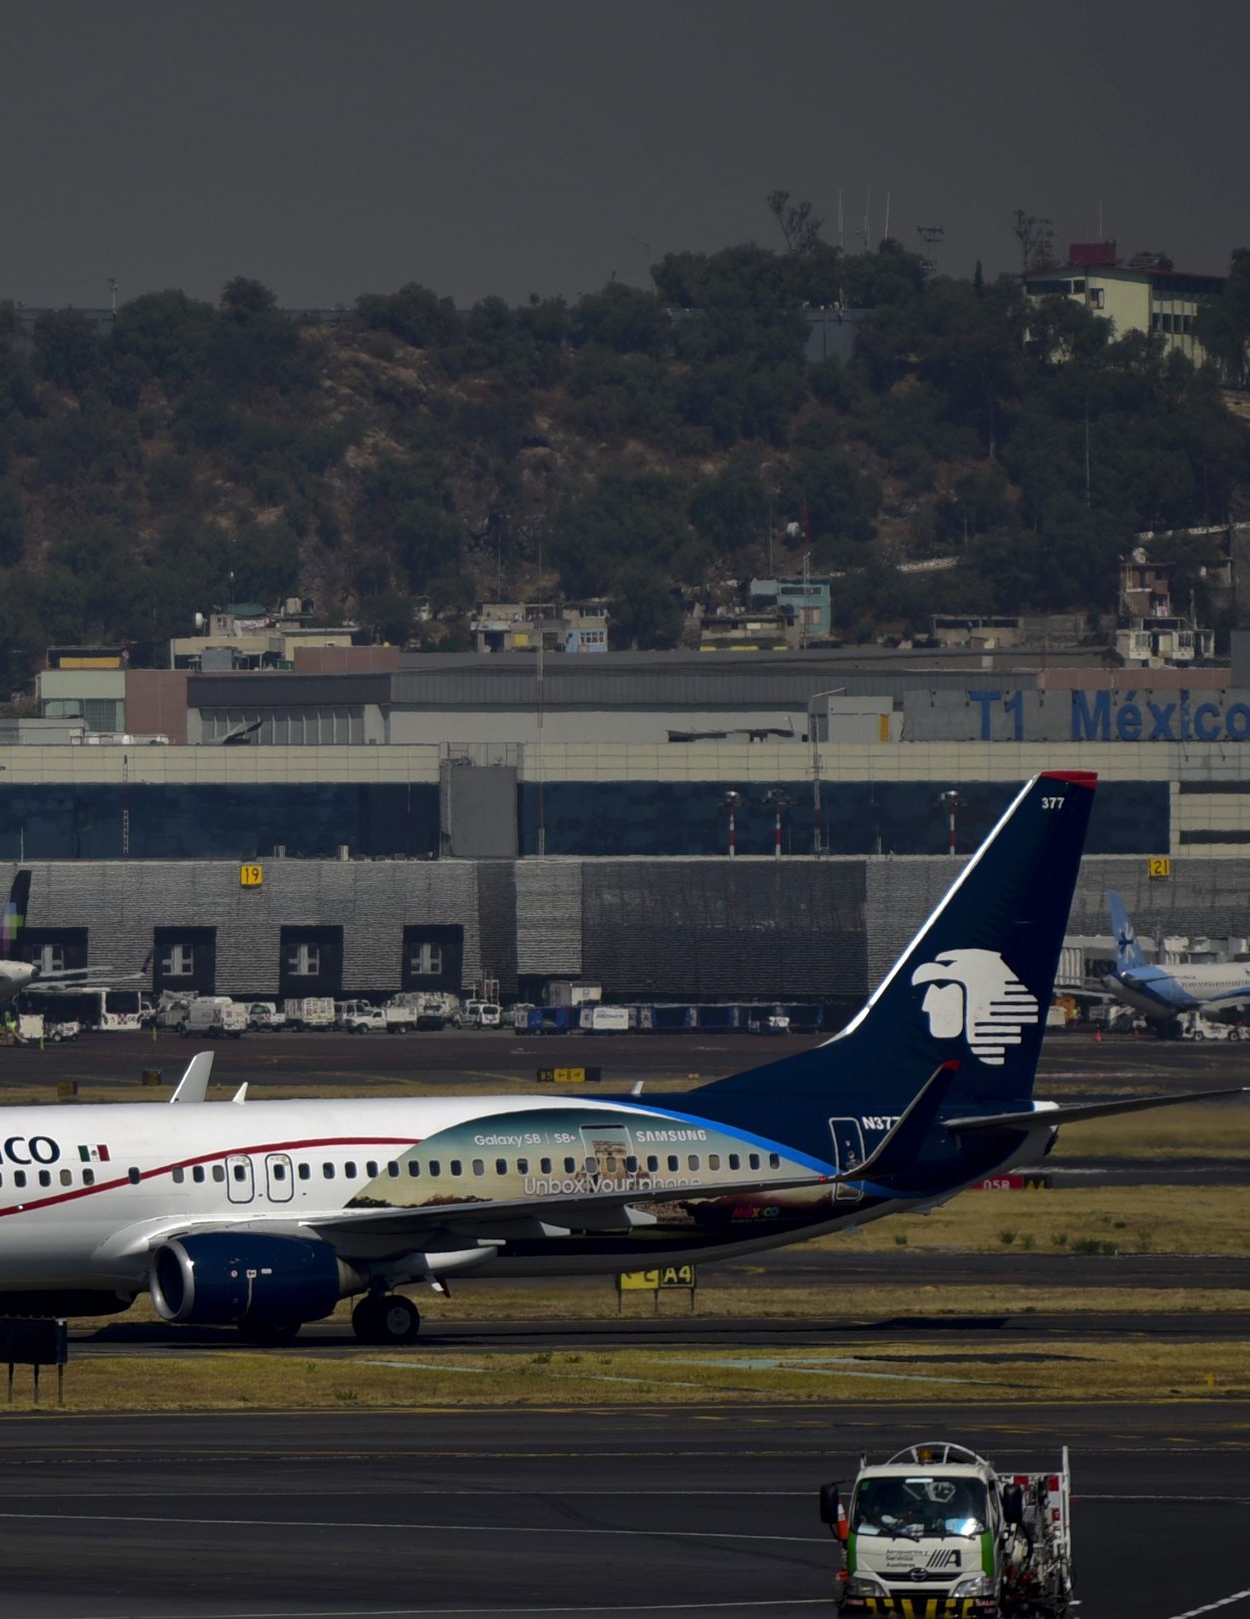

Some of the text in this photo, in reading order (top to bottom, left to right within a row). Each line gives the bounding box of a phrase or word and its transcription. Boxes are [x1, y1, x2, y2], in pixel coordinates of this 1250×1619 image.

[970, 690, 1023, 740] T1
[1041, 797, 1065, 810] 377
[1154, 860, 1167, 874] 21
[245, 868, 259, 882] 19
[474, 1132, 577, 1147] Galaxy S8 S8+
[636, 1129, 707, 1142] SAMSUNG
[524, 1176, 585, 1195] Unbox
[663, 1265, 691, 1283] A4
